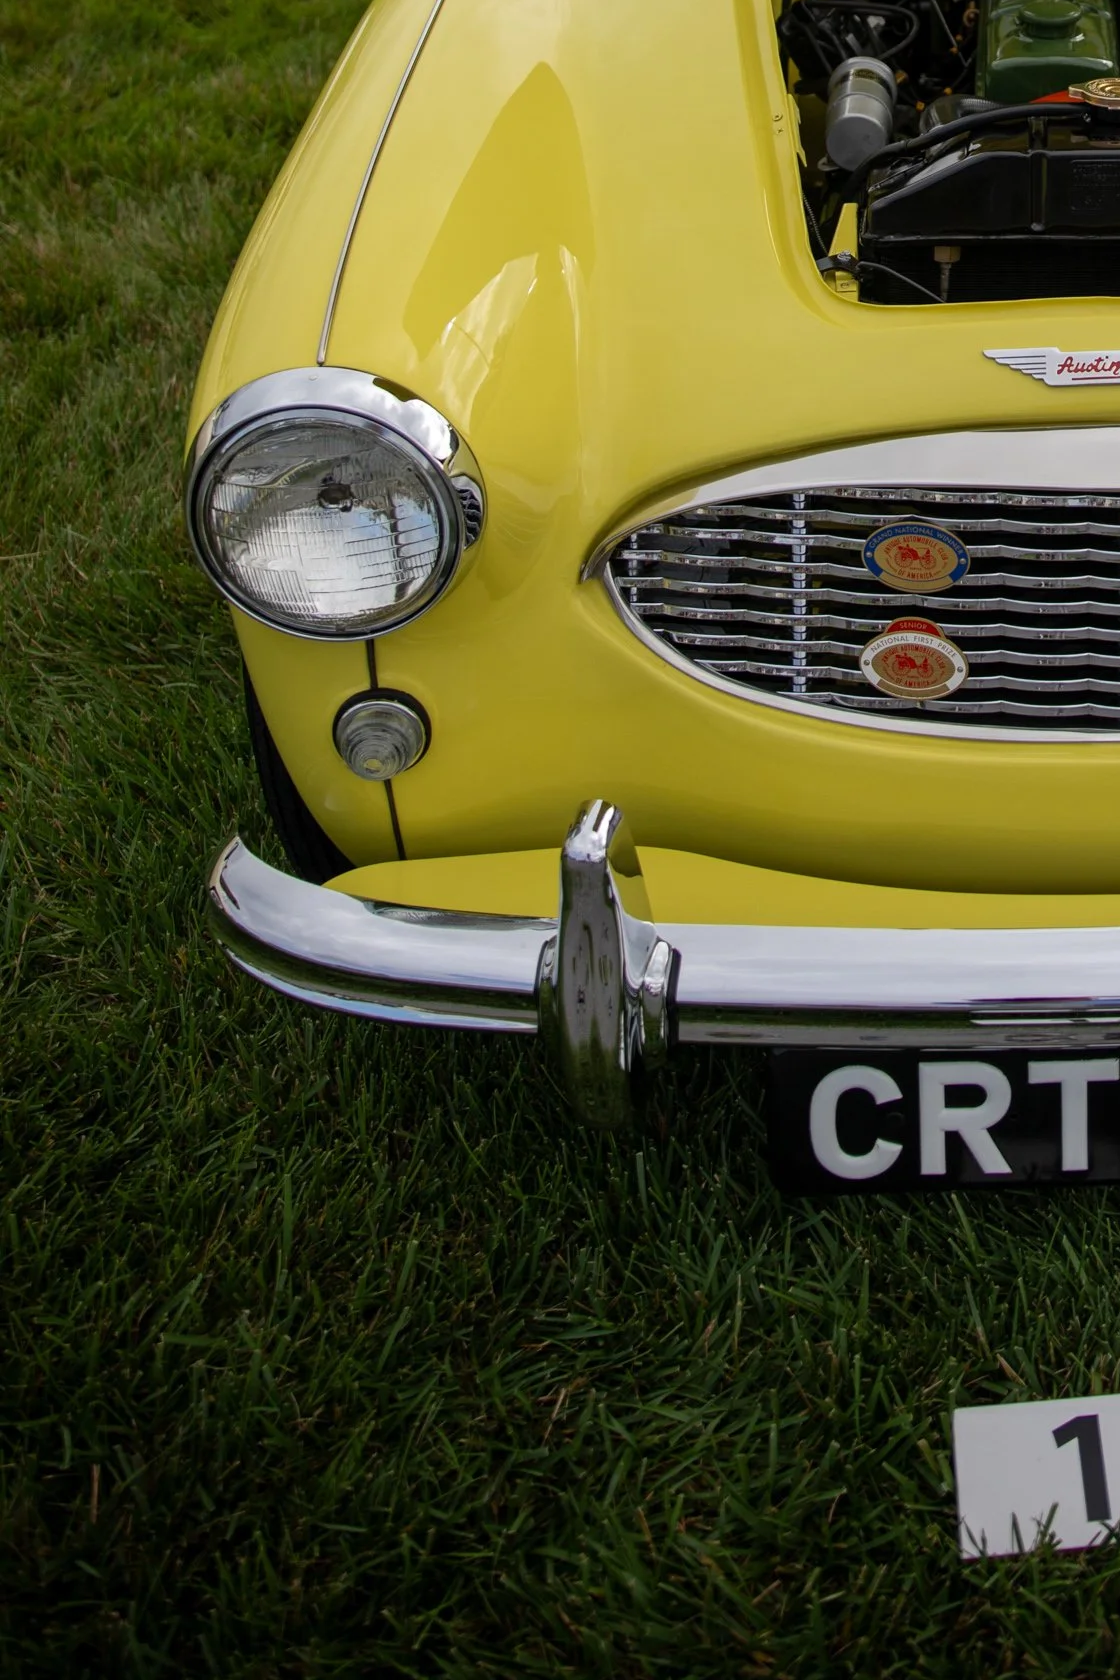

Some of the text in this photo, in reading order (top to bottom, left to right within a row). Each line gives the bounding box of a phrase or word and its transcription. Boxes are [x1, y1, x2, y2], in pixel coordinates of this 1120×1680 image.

[869, 526, 964, 555] GRAND NATIONAL WINNER
[903, 536, 937, 548] AUTOMOBILE
[937, 548, 948, 561] CLUB
[898, 569, 904, 577] OF
[871, 635, 958, 658] NATIONAL FIRST PRIZE
[901, 644, 934, 657] AUTOMOBILE
[935, 655, 946, 669] CLUB
[809, 1058, 1120, 1180] CRT
